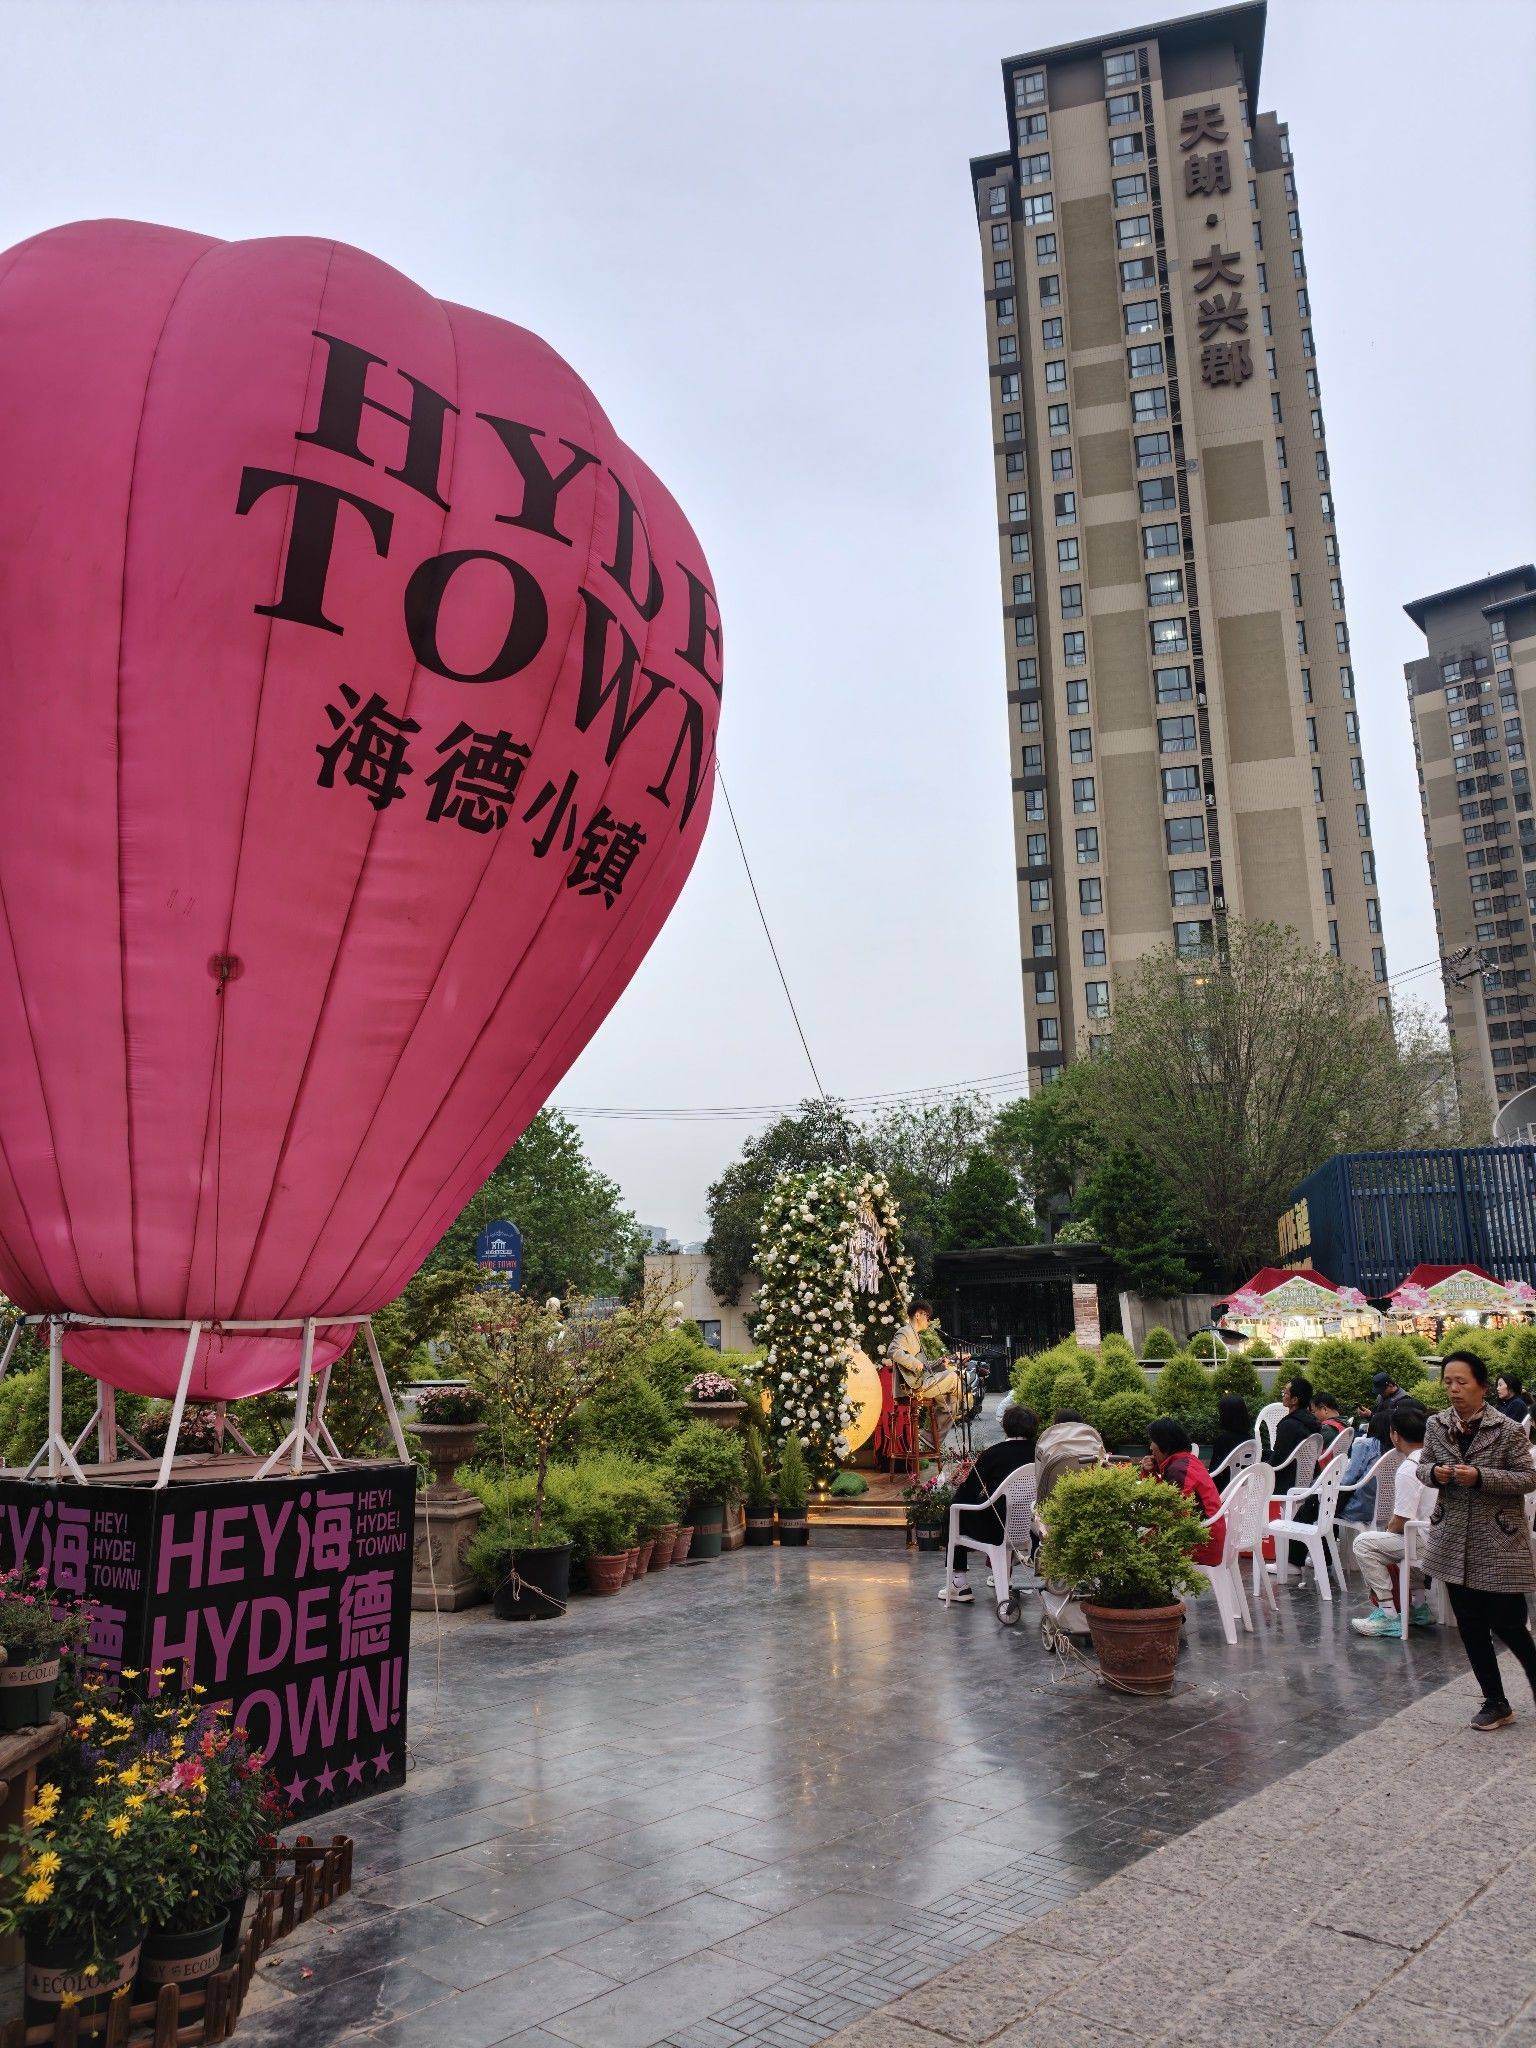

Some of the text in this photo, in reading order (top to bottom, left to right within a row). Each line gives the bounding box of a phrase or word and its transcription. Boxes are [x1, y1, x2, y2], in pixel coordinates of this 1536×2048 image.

[294, 330, 723, 700] HYDE
[235, 465, 717, 833] TOWN
[316, 683, 647, 910] 海德小镇
[358, 1489, 392, 1511] HEY!
[94, 1511, 129, 1534] HEY!
[356, 1511, 400, 1534] HYDE!
[92, 1537, 137, 1562] HYDE!
[355, 1532, 407, 1558] TOWN!
[92, 1564, 142, 1591] TOWN!
